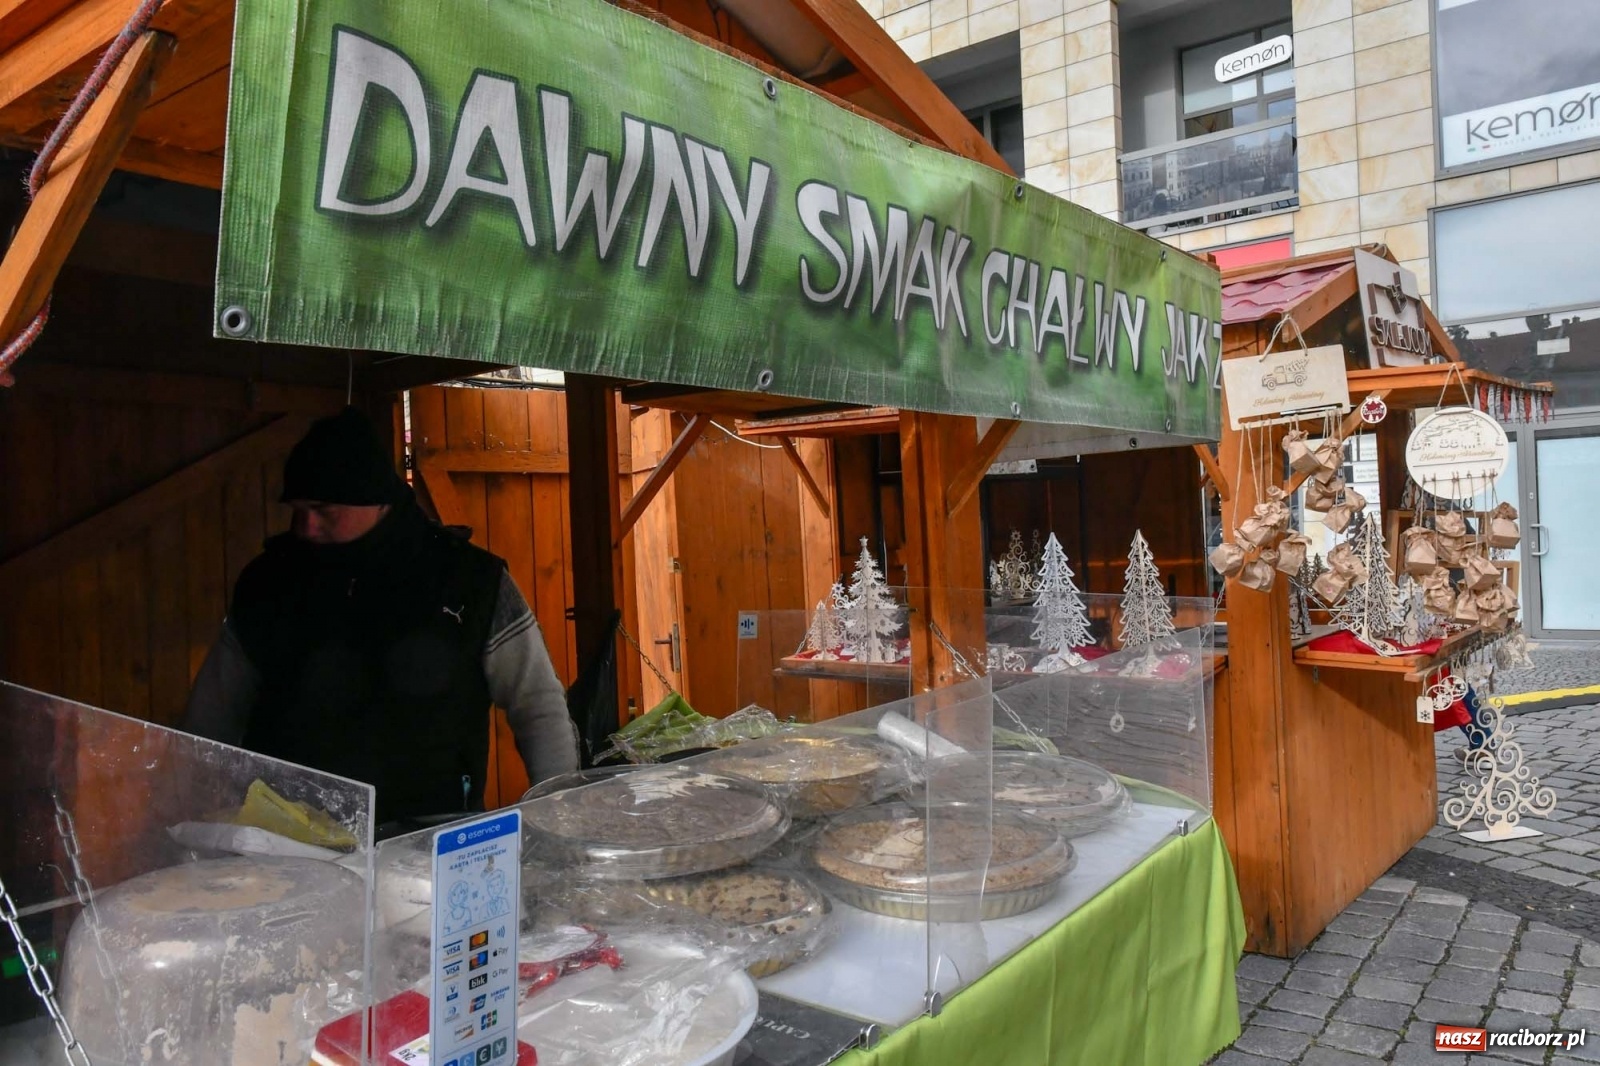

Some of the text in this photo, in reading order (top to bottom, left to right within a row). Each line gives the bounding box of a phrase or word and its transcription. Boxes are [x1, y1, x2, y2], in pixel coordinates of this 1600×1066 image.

[318, 26, 771, 286] DAWNY
[796, 180, 971, 338] SMAK
[980, 248, 1146, 372] CHAŁWY
[1161, 302, 1209, 383] JAK
[467, 824, 501, 840] eservice
[446, 944, 461, 956] VISA
[446, 964, 460, 976] VISA
